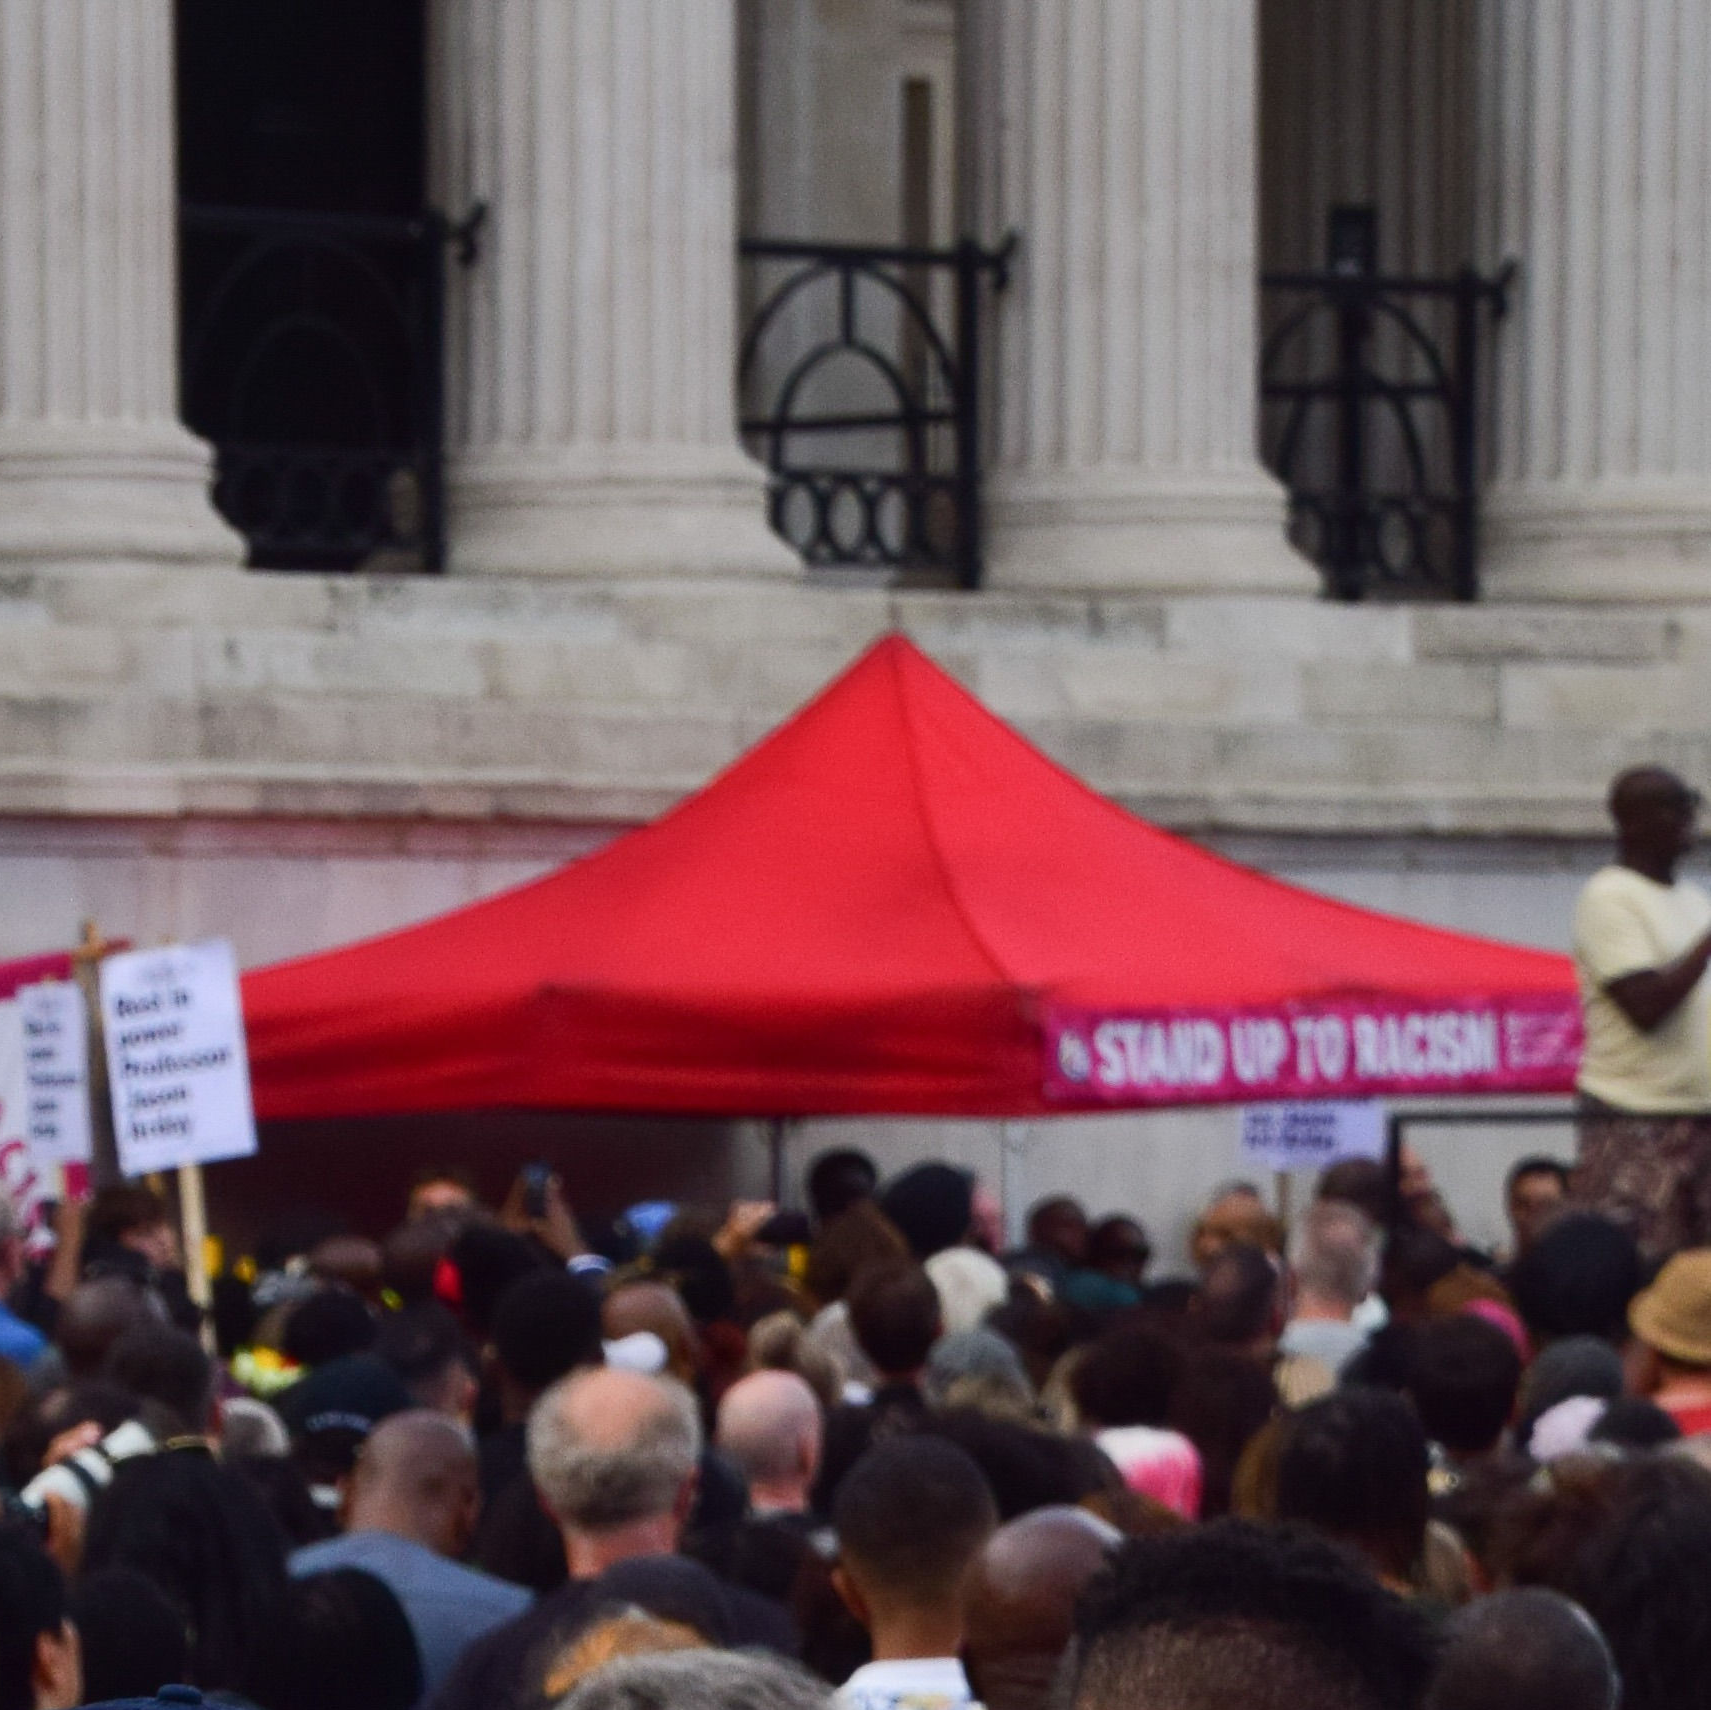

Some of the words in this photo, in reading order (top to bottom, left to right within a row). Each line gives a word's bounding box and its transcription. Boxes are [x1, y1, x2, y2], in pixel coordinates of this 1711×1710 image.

[1093, 1016, 1226, 1088] STAND
[1229, 1012, 1288, 1084] UP
[1294, 1010, 1344, 1082] TO
[1354, 1008, 1499, 1079] RACISM
